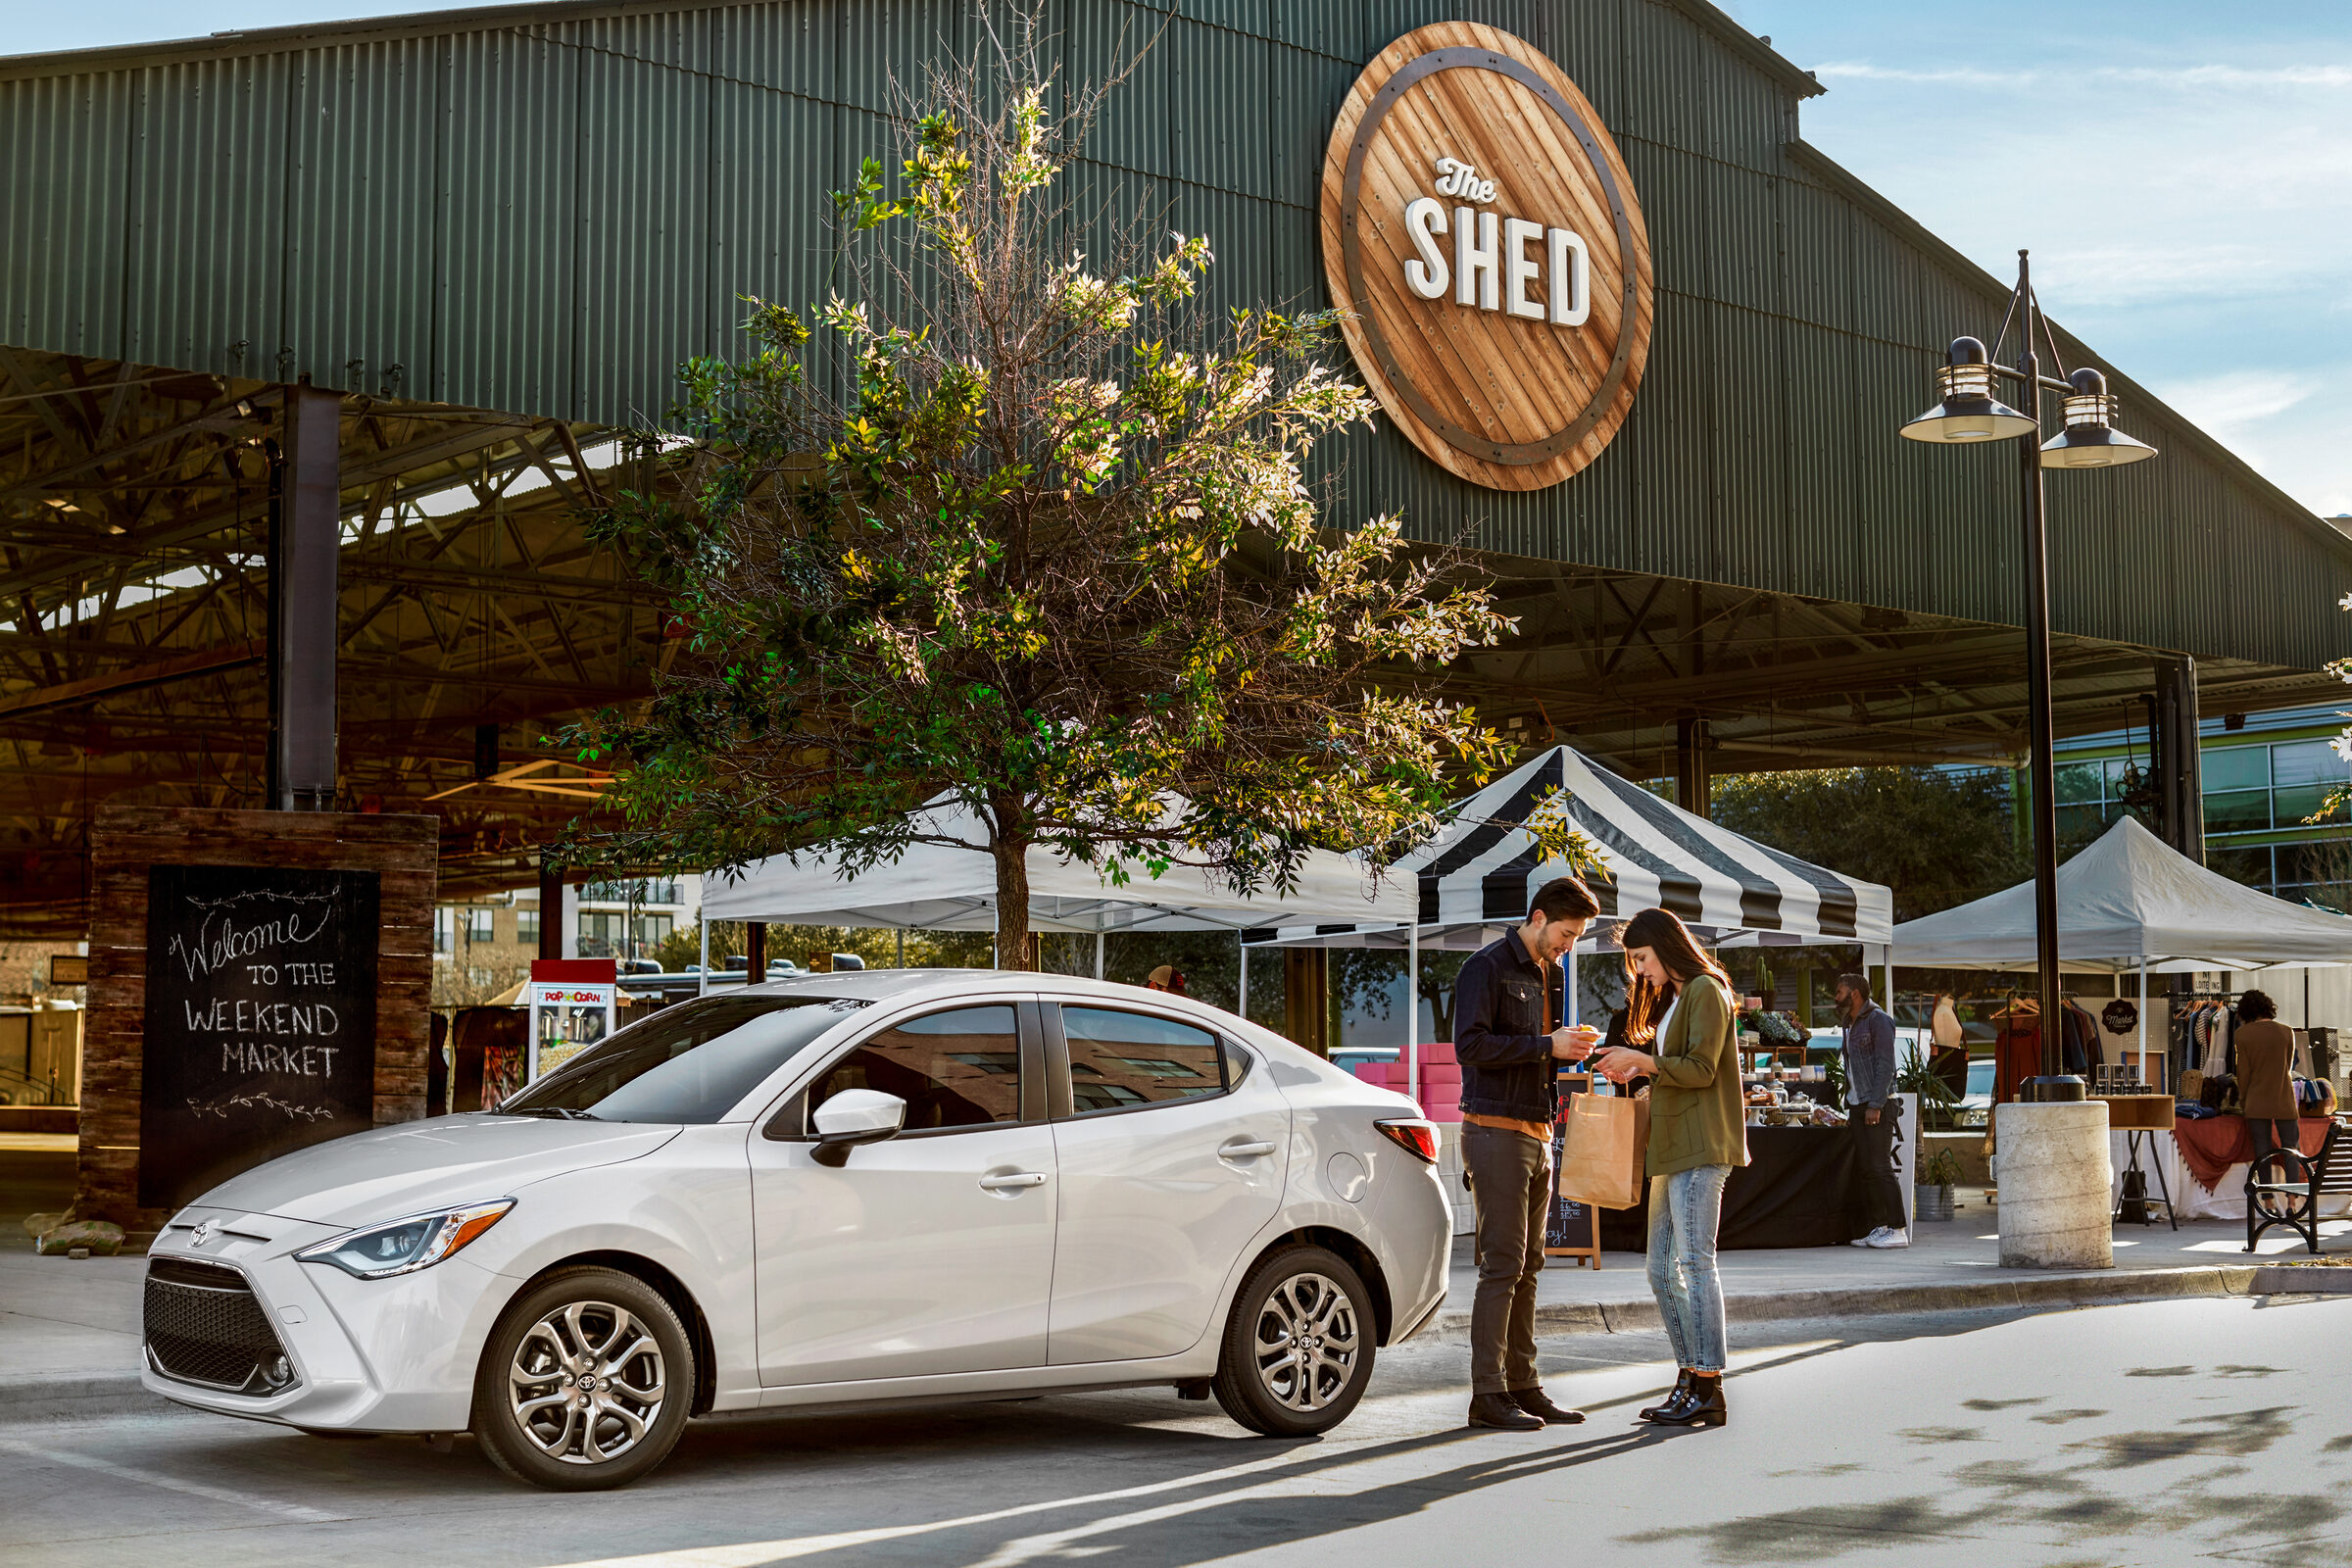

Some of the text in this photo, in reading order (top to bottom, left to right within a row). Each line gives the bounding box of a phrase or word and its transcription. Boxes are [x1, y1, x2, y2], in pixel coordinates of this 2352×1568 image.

[1436, 157, 1496, 204] The
[1404, 197, 1591, 327] SHED
[170, 905, 331, 982] Welcome
[247, 962, 336, 986] TO THE
[185, 997, 339, 1036] WEEKEND
[2106, 1013, 2133, 1025] Market
[222, 1042, 339, 1079] MARKET
